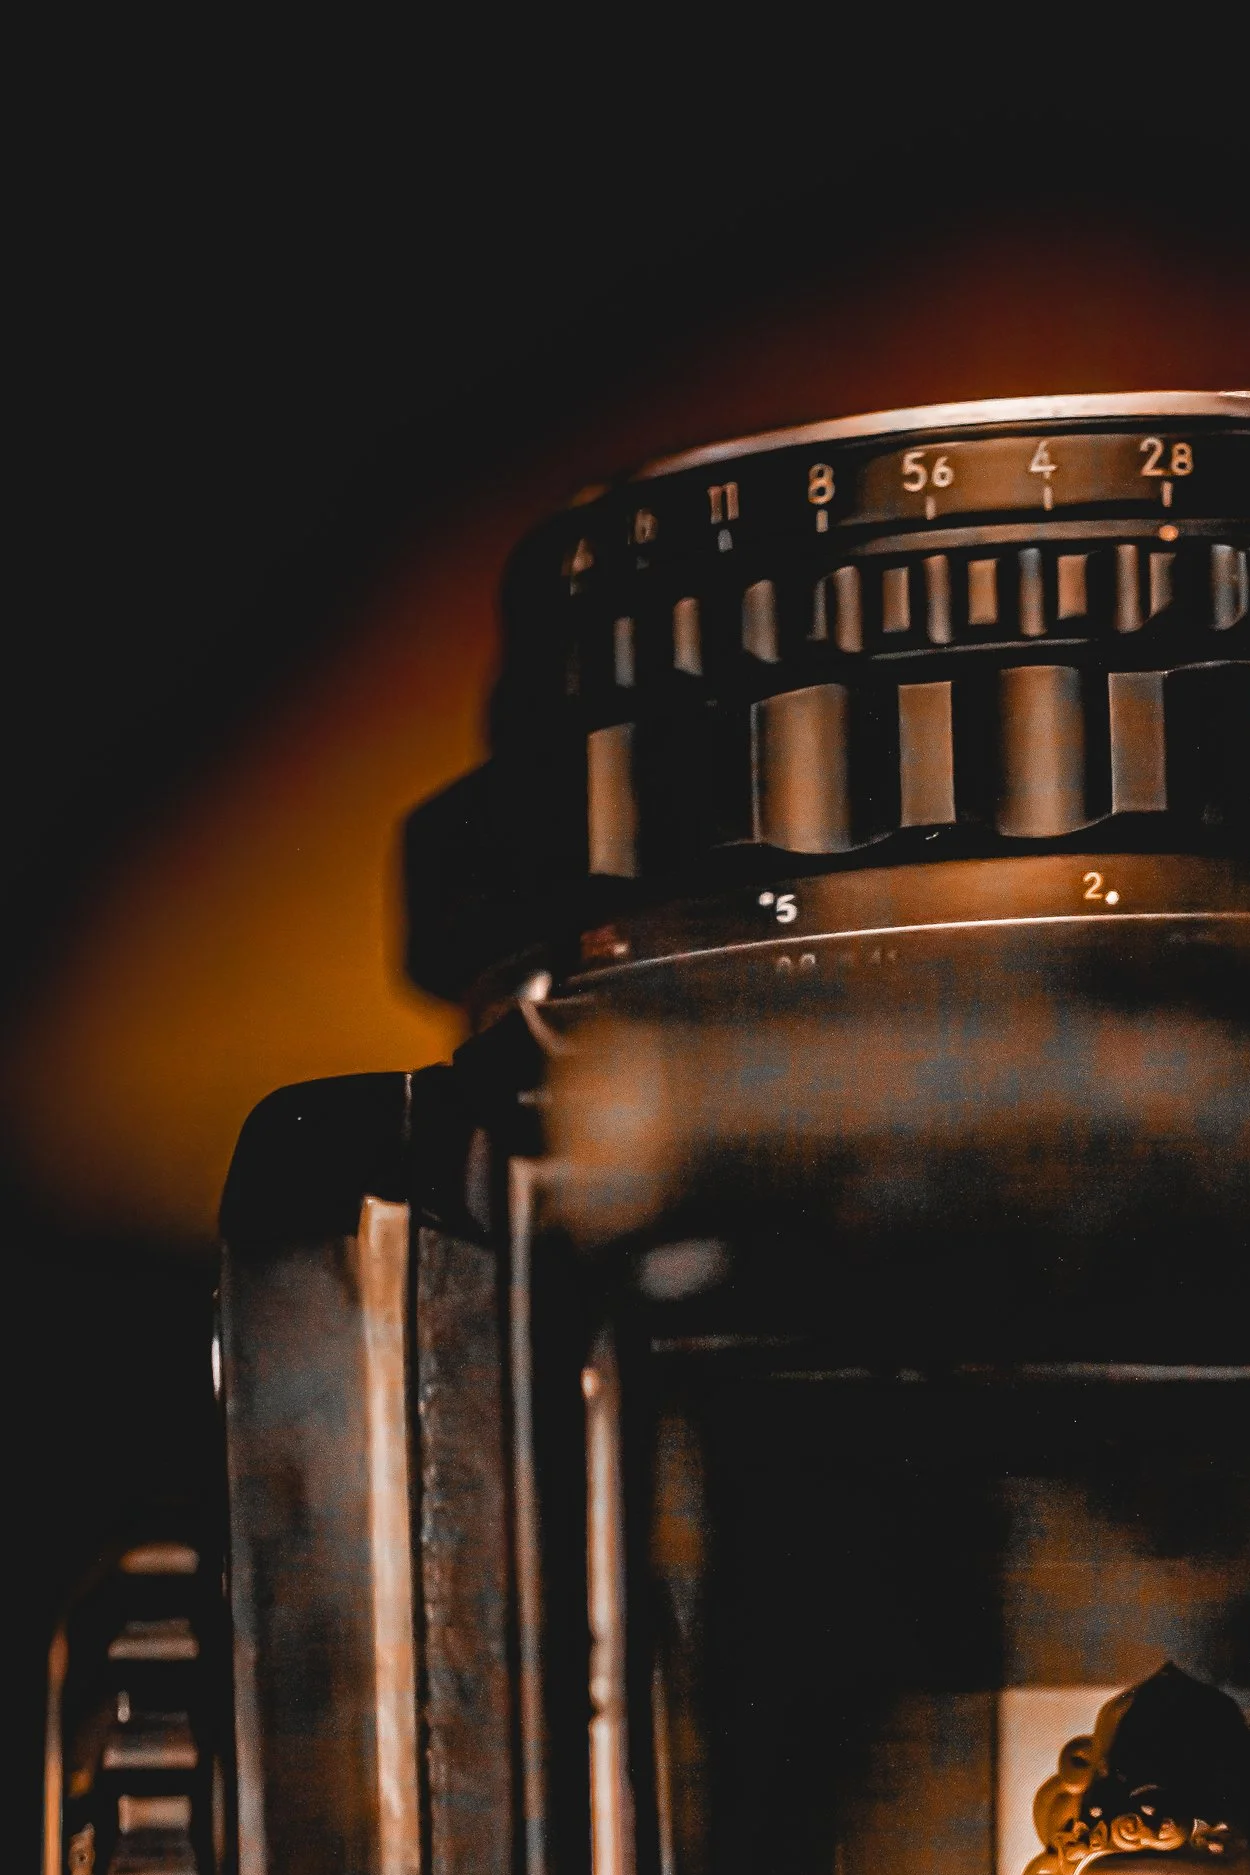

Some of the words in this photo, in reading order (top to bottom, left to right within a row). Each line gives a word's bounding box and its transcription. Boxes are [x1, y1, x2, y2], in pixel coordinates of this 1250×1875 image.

[808, 463, 835, 504] 8
[1028, 440, 1057, 479] 4
[775, 893, 798, 924] 5
[1083, 870, 1106, 901] 2
